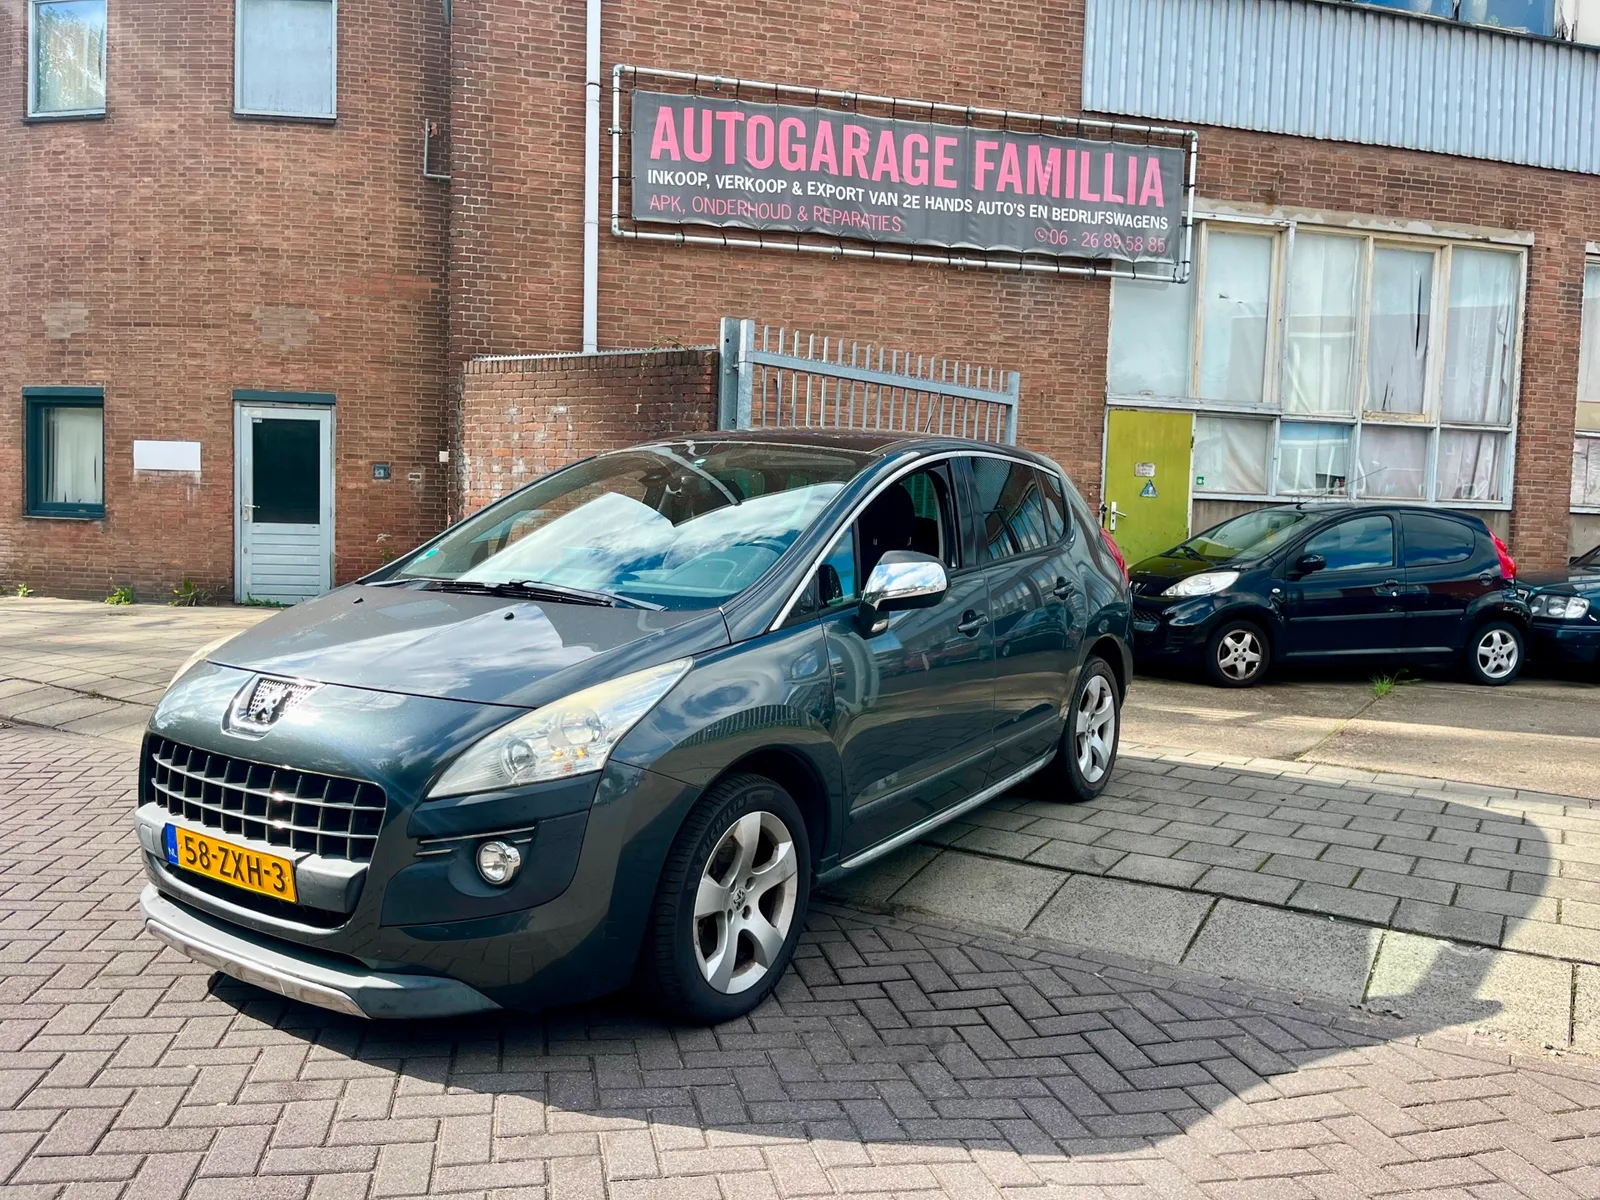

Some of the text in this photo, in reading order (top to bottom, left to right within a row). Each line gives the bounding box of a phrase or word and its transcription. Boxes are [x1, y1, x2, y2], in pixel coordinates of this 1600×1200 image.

[650, 106, 1165, 208] AUTOGARAGE FAMILLIA
[647, 169, 1168, 230] INKOOP, VERKOOP & EXPORT VAN 2E HANDS AUTO'S EN BEDRIJFSWAGENS
[650, 194, 902, 233] APK, ONDERHOUD & REPARATIES
[1050, 230, 1068, 245] 06
[1081, 232, 1098, 248] 26
[1103, 232, 1121, 249] 89
[1126, 236, 1143, 252] 58
[1148, 236, 1166, 253] 85
[183, 835, 287, 893] 58-ZXH-3
